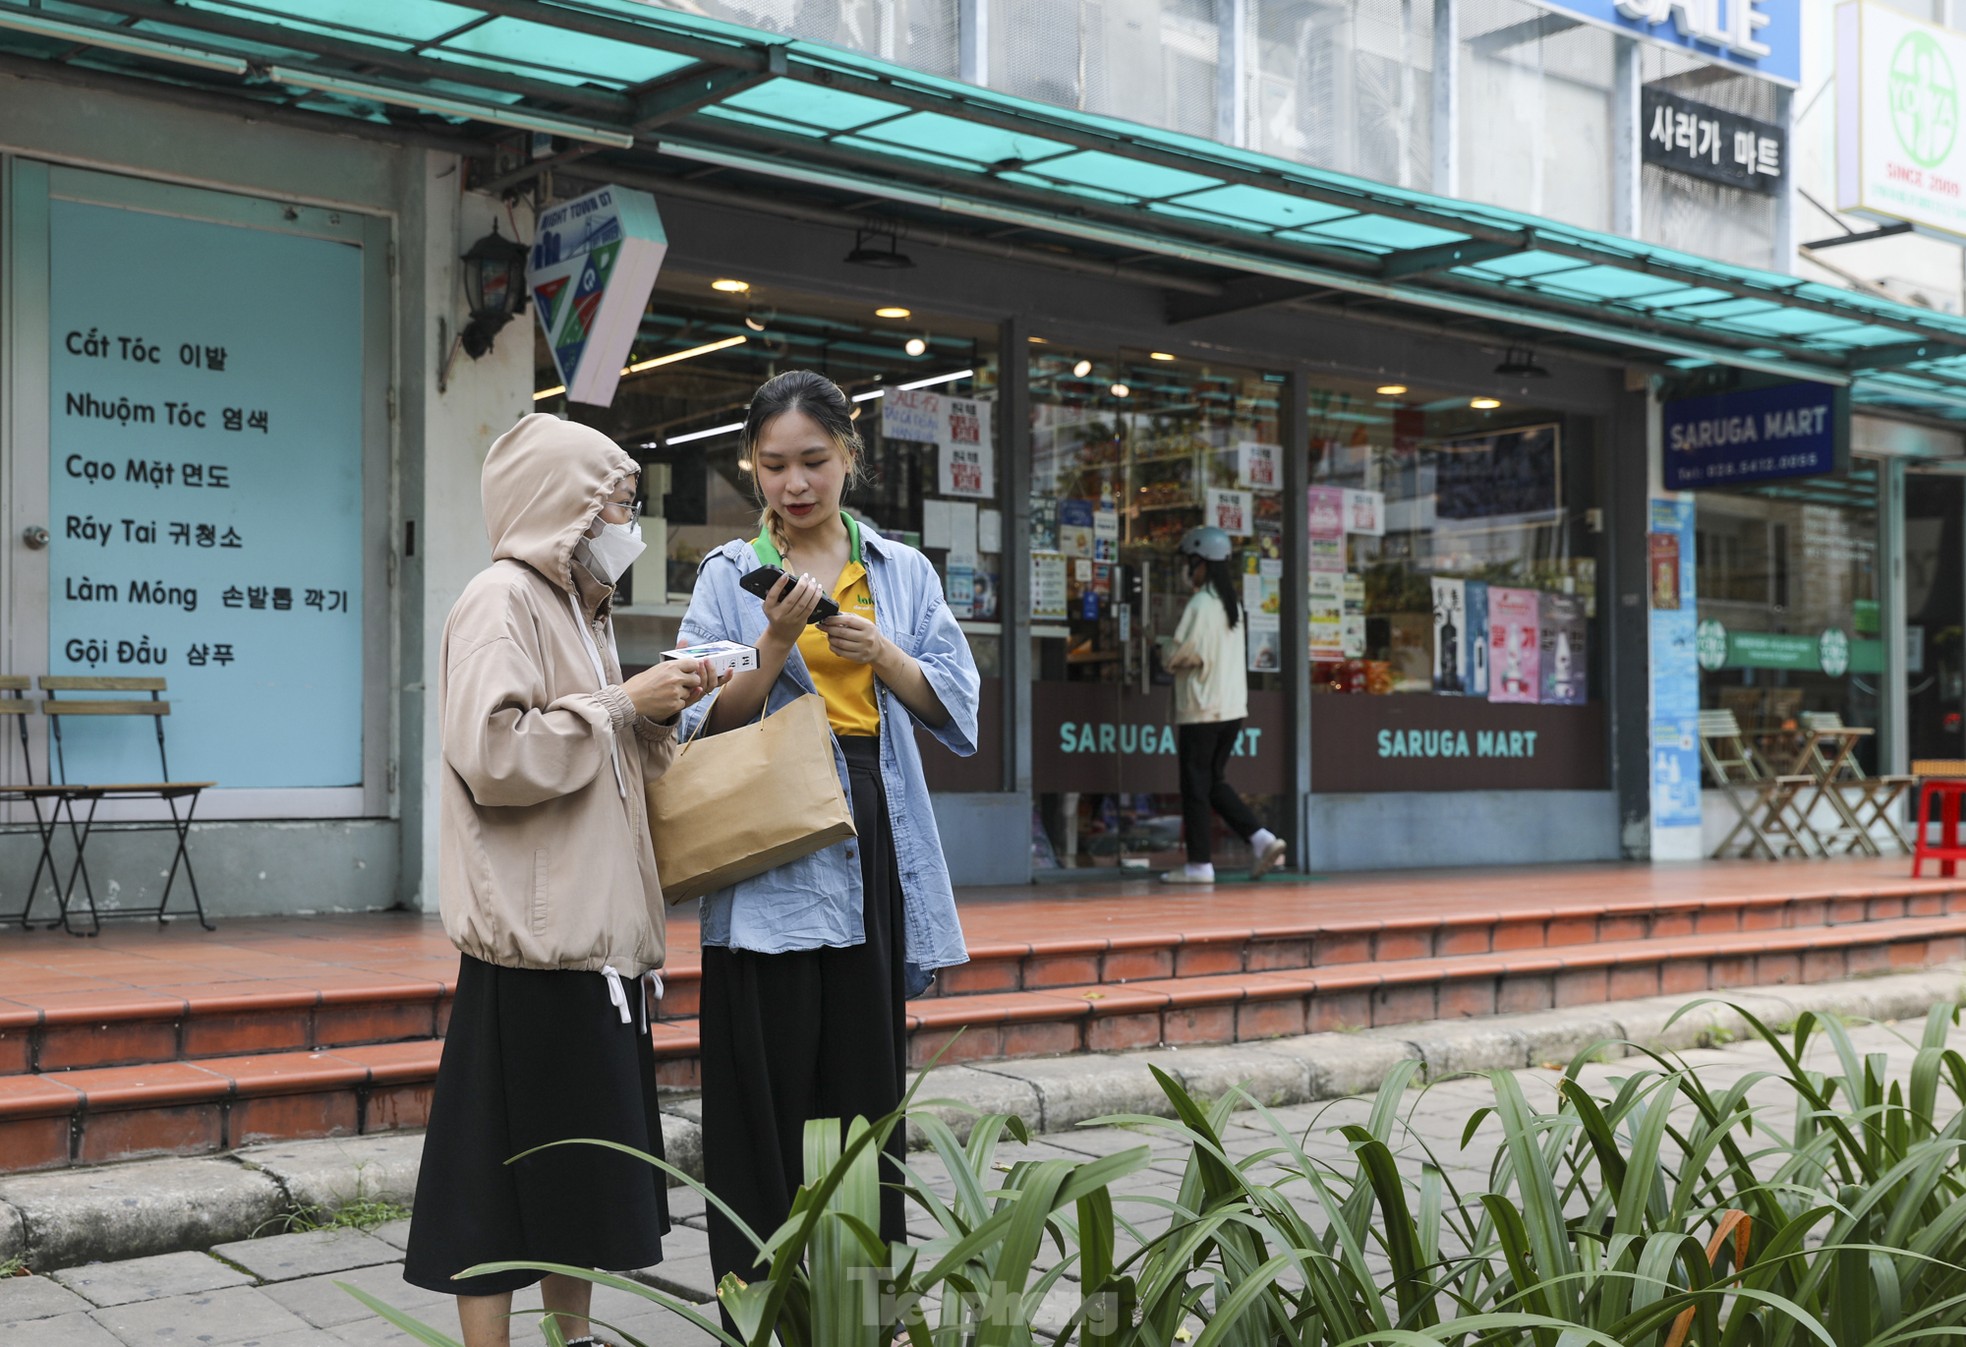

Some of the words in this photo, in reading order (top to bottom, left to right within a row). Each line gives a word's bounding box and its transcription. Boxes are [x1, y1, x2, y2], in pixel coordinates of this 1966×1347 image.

[1650, 105, 1722, 164] 사러가
[1733, 131, 1781, 176] 마트
[570, 197, 599, 219] TOWN
[65, 328, 110, 358] Cắt
[118, 337, 161, 364] Tóc
[179, 343, 228, 372] 이발
[65, 392, 155, 426] Nhuộm
[164, 401, 207, 428] Tóc
[222, 407, 269, 434] 염색
[1670, 414, 1759, 450] SARUGA
[1764, 405, 1828, 440] MART
[65, 454, 116, 484] Cạo
[126, 459, 174, 489] Mặt
[182, 464, 231, 489] 면도
[65, 515, 112, 547] Ráy
[121, 519, 156, 544] Tai
[168, 522, 243, 549] 귀청소
[65, 576, 118, 603] Làm
[128, 579, 198, 613] Móng
[65, 638, 108, 669] Gội
[117, 636, 168, 665] Đầu
[1060, 721, 1178, 754] SARUGA
[1229, 727, 1262, 757] RT
[1378, 729, 1470, 757] SARUGA
[1477, 731, 1537, 757] MART
